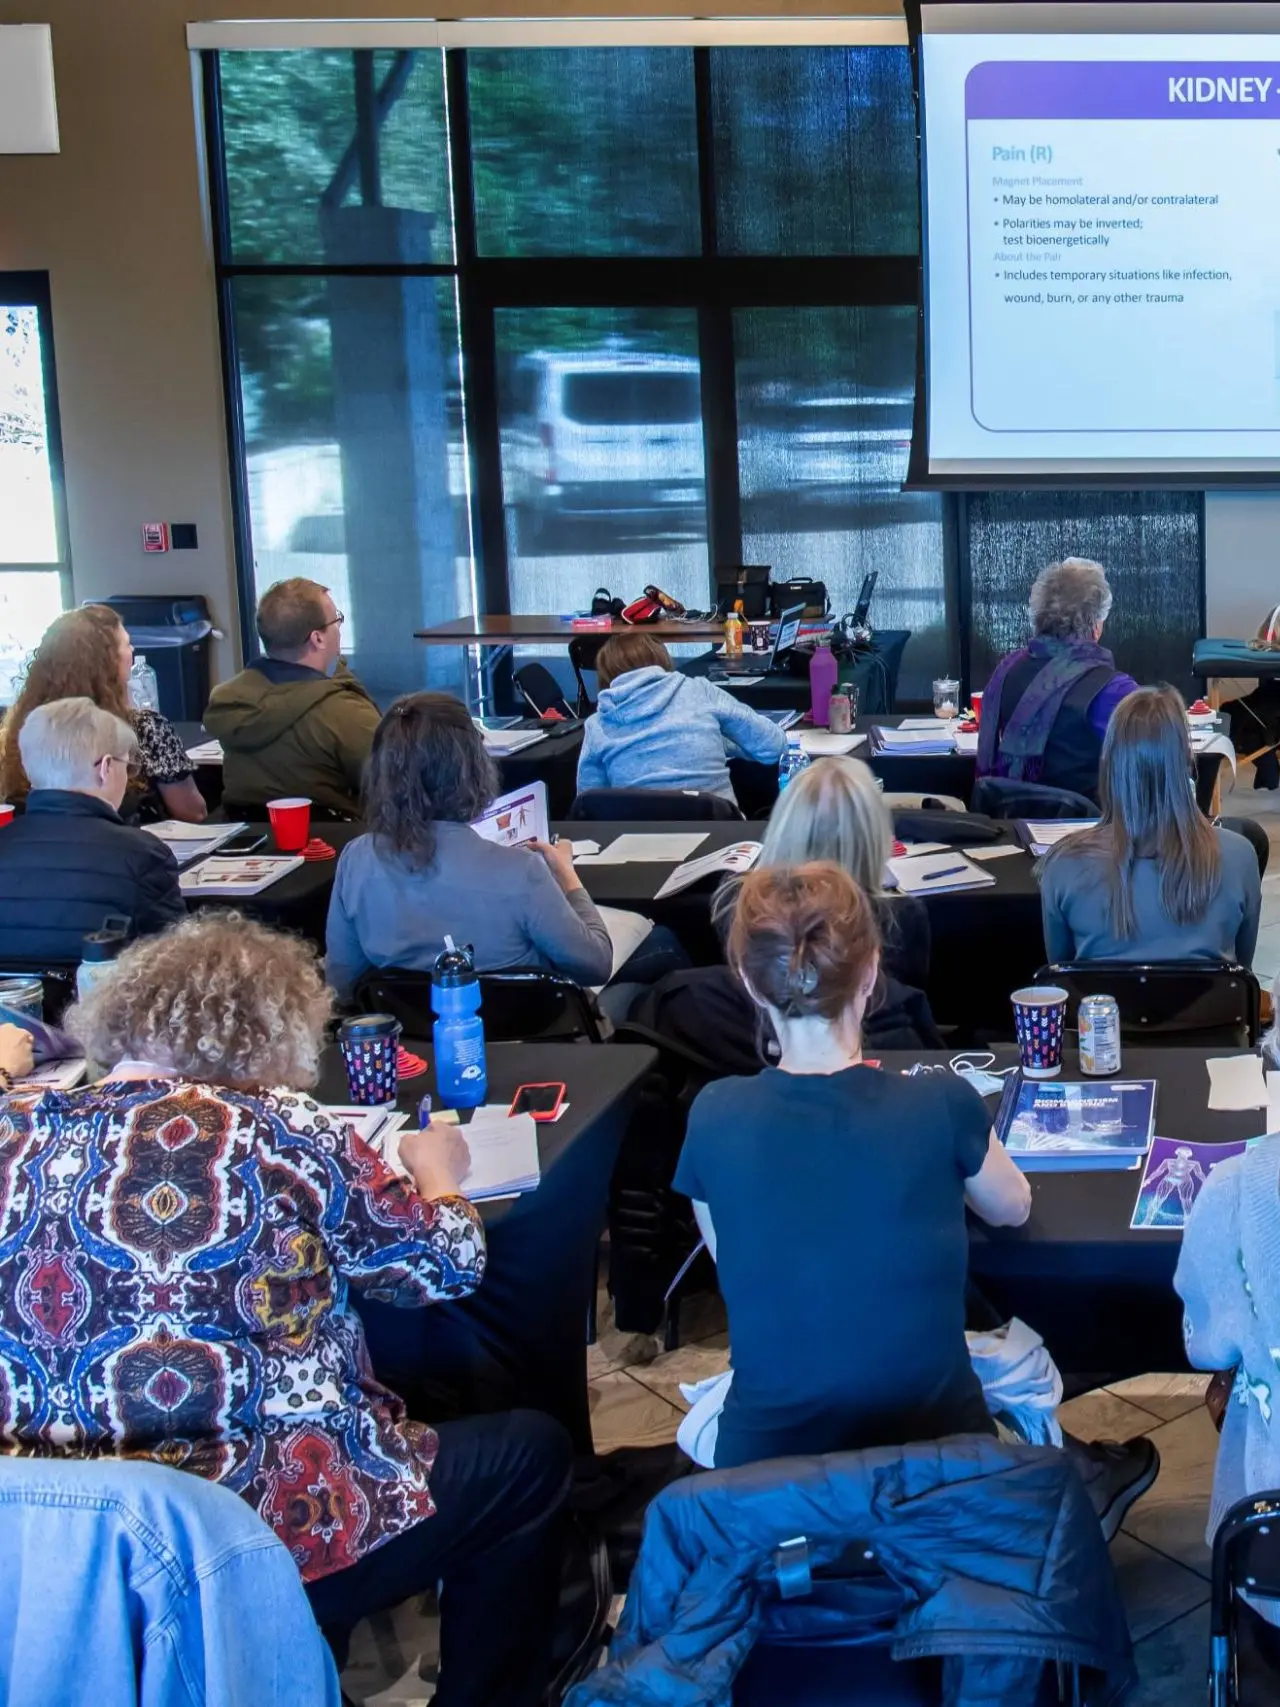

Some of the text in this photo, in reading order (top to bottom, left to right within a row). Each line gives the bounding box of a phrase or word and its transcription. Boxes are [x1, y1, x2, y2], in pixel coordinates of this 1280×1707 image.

[1168, 77, 1272, 102] KIDNEY
[992, 144, 1052, 164] Pain (R)
[992, 175, 1083, 188] Magnet Placement
[1002, 194, 1219, 207] May be homolateral and/or contralateral
[1003, 218, 1143, 231] Polarities may be inverted;
[1003, 235, 1110, 247] test bioenergetically
[994, 252, 1023, 262] About
[1026, 252, 1042, 261] the
[1003, 268, 1232, 282] Includes temporary situations like infection,
[1004, 292, 1184, 304] wound, burn, or any other trauma
